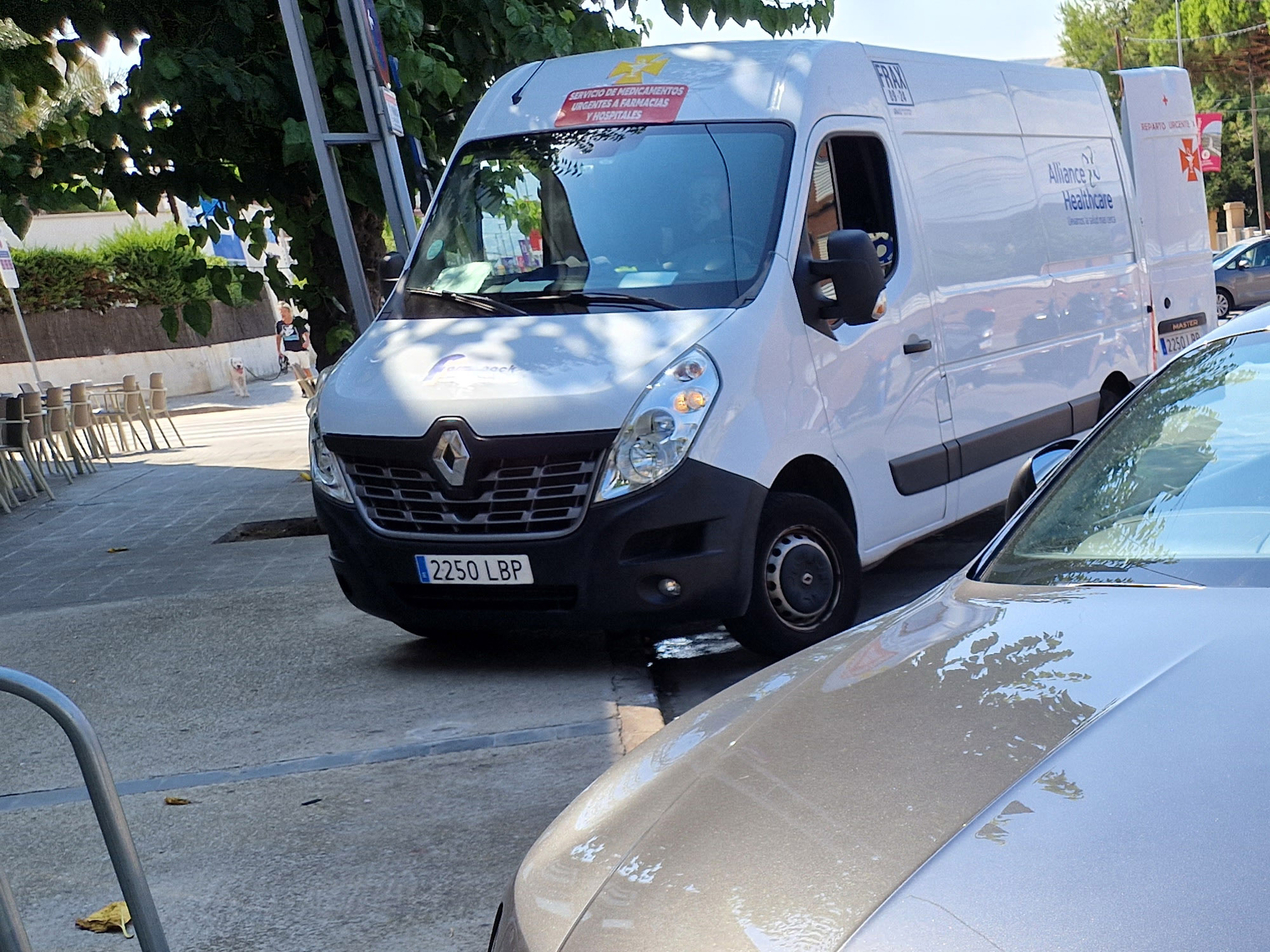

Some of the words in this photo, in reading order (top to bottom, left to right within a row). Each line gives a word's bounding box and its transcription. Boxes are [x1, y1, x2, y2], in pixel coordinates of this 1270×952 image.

[873, 64, 908, 90] FRAX
[569, 91, 604, 100] SERVICIO
[605, 89, 615, 97] DE
[617, 86, 685, 96] MEDICAMENTOS
[571, 99, 611, 111] URGENTES
[611, 98, 619, 107] A
[619, 98, 670, 108] FARMACIAS
[586, 112, 594, 122] Y
[593, 110, 643, 120] HOSPITALES
[1140, 122, 1167, 130] REPARTO
[1048, 161, 1087, 184] Alliance
[1062, 187, 1114, 211] Healthcare
[1172, 320, 1198, 330] MASTER
[1166, 336, 1185, 352] 2250
[430, 560, 479, 581] 2250
[484, 560, 522, 581] LBP
